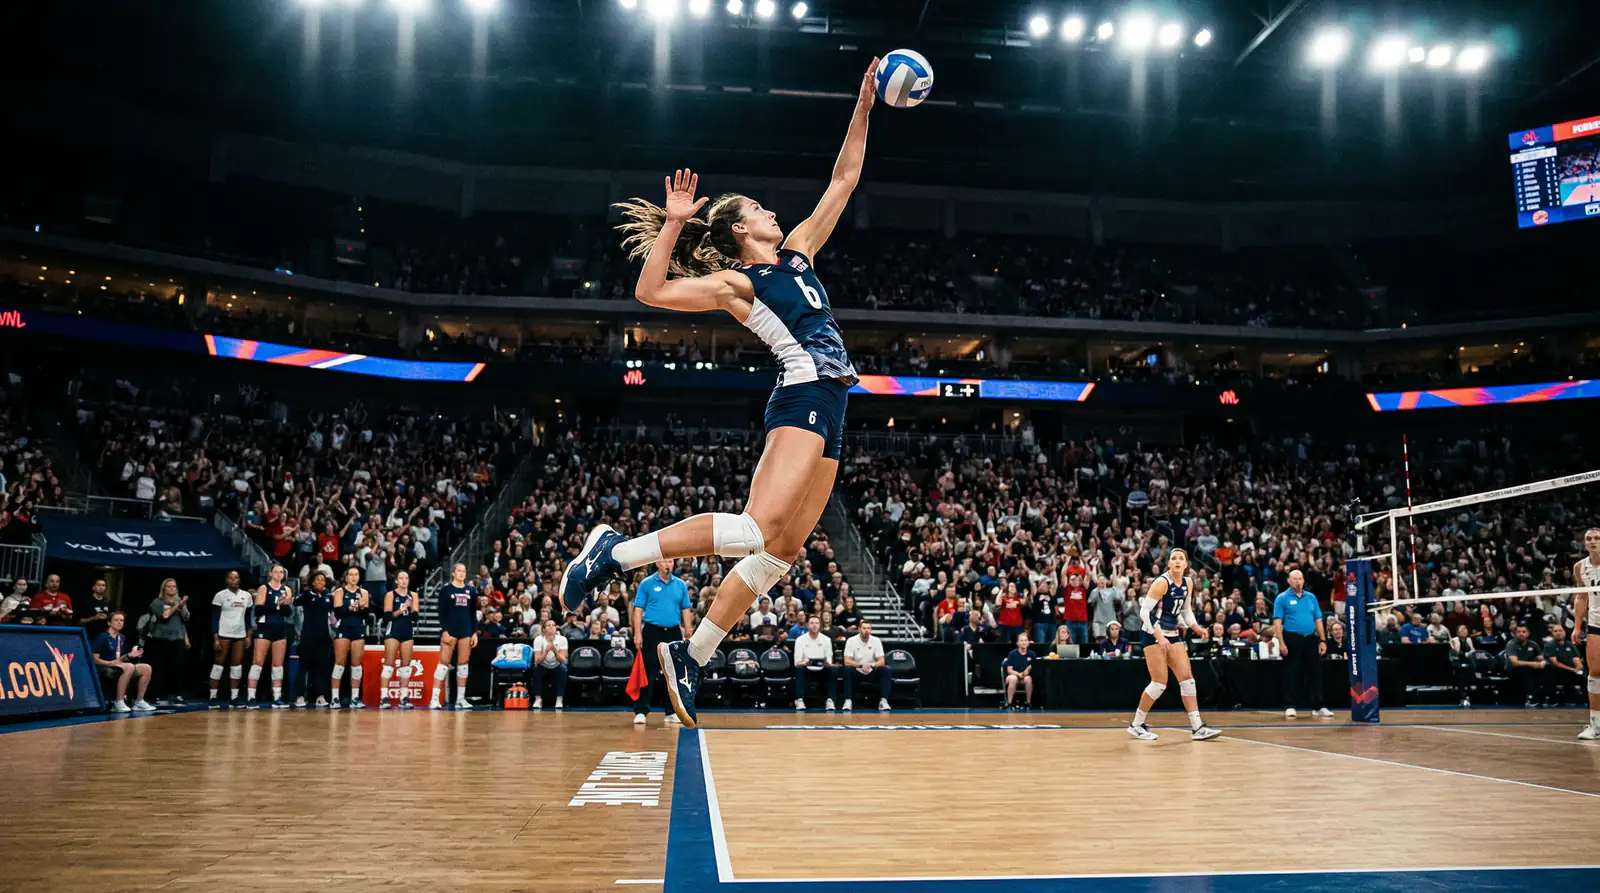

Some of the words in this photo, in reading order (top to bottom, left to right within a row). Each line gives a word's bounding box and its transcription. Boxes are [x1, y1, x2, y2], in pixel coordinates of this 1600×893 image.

[794, 276, 822, 309] 6
[808, 410, 817, 425] 6
[64, 541, 213, 557] VOLLEYBALL
[586, 751, 668, 780] SERVICE
[568, 782, 662, 806] LINE
